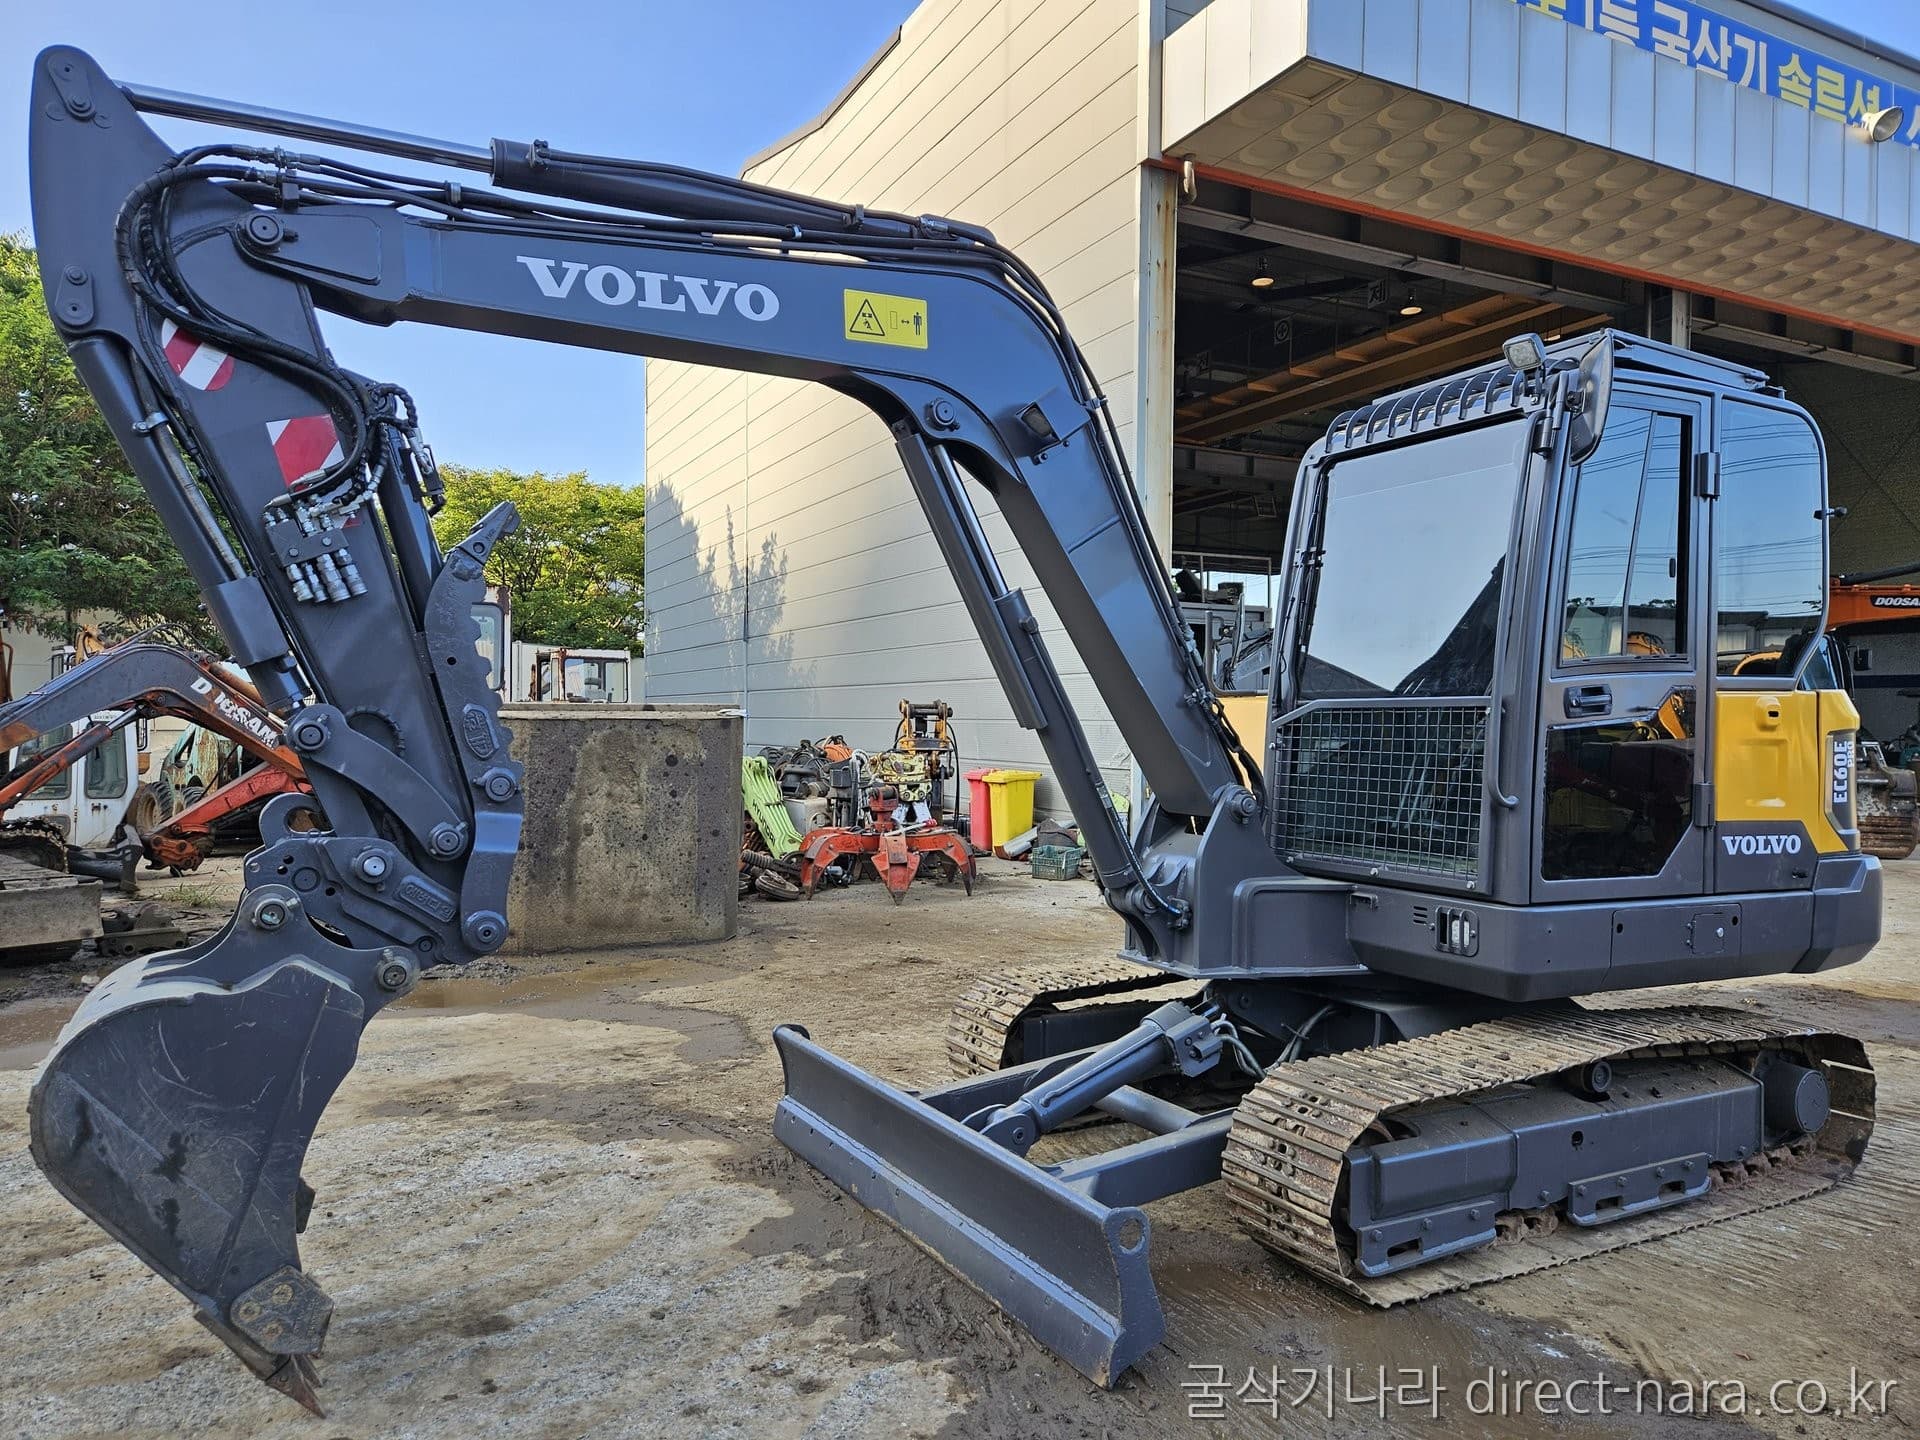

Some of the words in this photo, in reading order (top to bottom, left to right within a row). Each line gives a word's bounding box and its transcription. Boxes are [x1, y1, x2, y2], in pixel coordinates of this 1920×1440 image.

[516, 255, 780, 322] VOLVO
[1874, 597, 1920, 606] DOOSA
[1834, 741, 1848, 803] EC60E
[1722, 834, 1802, 855] VOLVO
